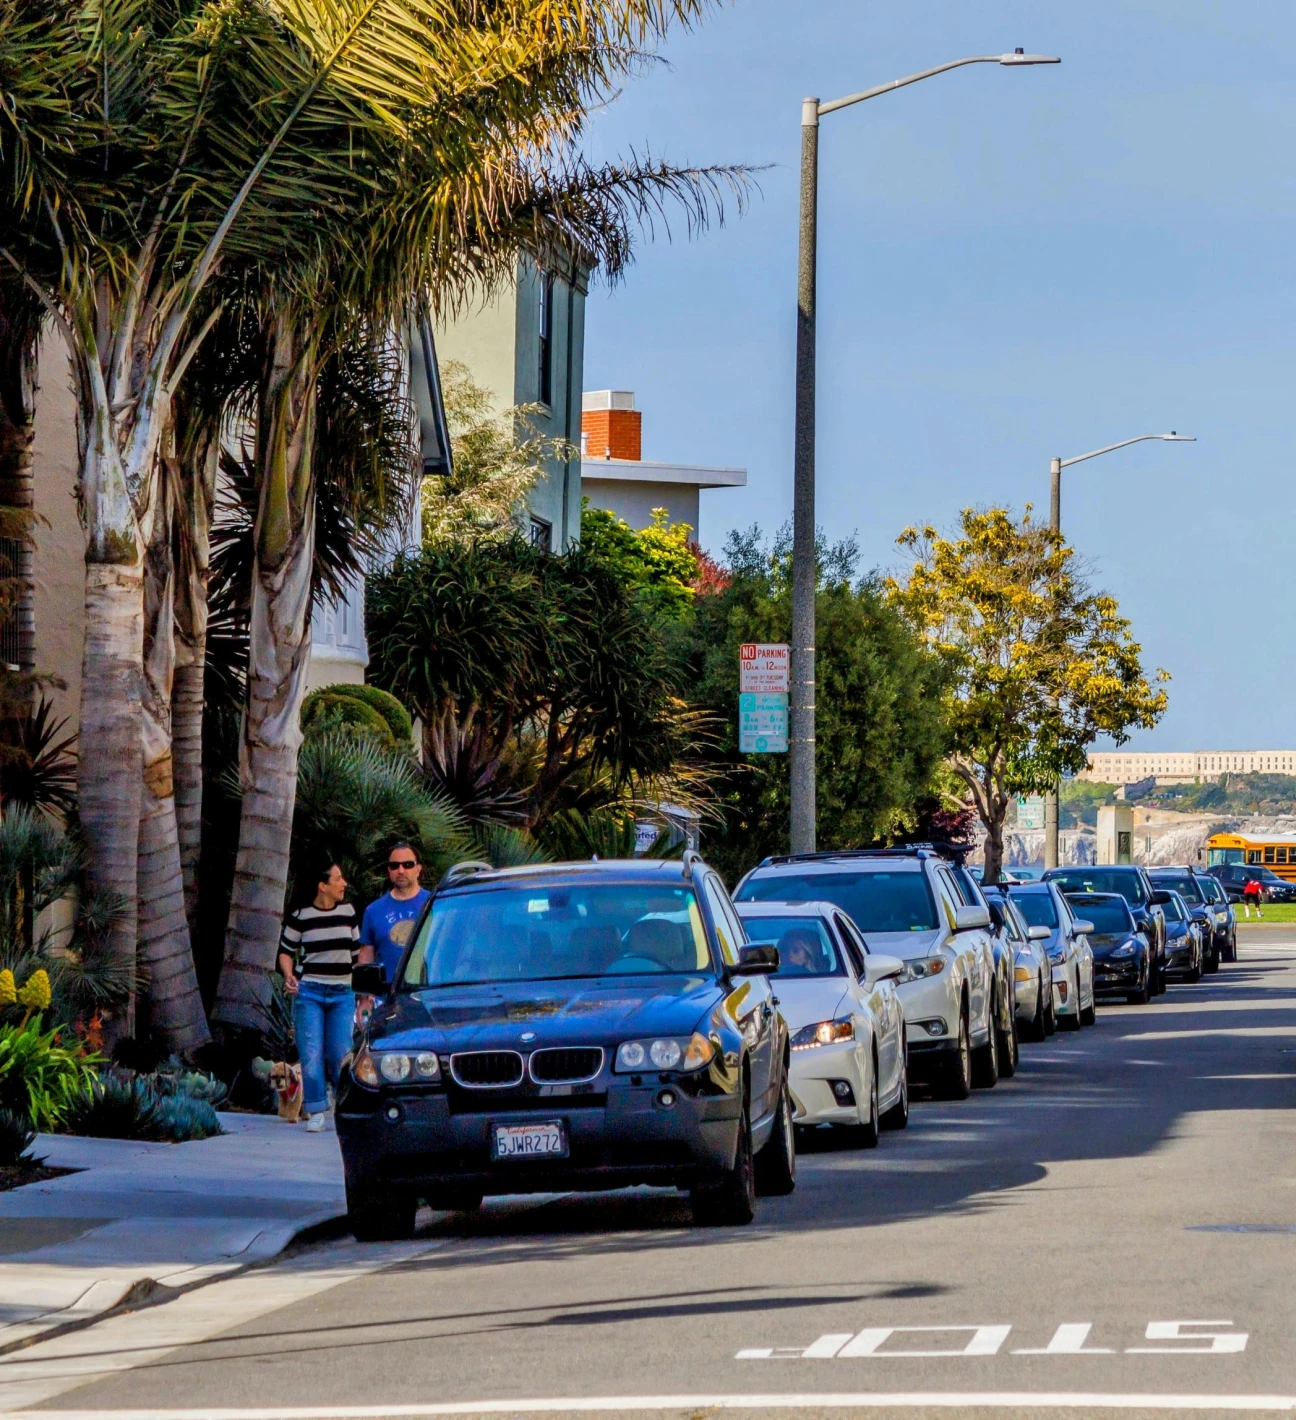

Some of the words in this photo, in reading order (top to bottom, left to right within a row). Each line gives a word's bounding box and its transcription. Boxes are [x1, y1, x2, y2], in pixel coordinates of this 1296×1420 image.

[742, 646, 755, 659] NO
[757, 649, 786, 659] PARKING
[743, 696, 753, 708] 2
[506, 1126, 550, 1135] California
[498, 1134, 560, 1154] 5JWR272
[735, 1320, 1248, 1359] STOP
